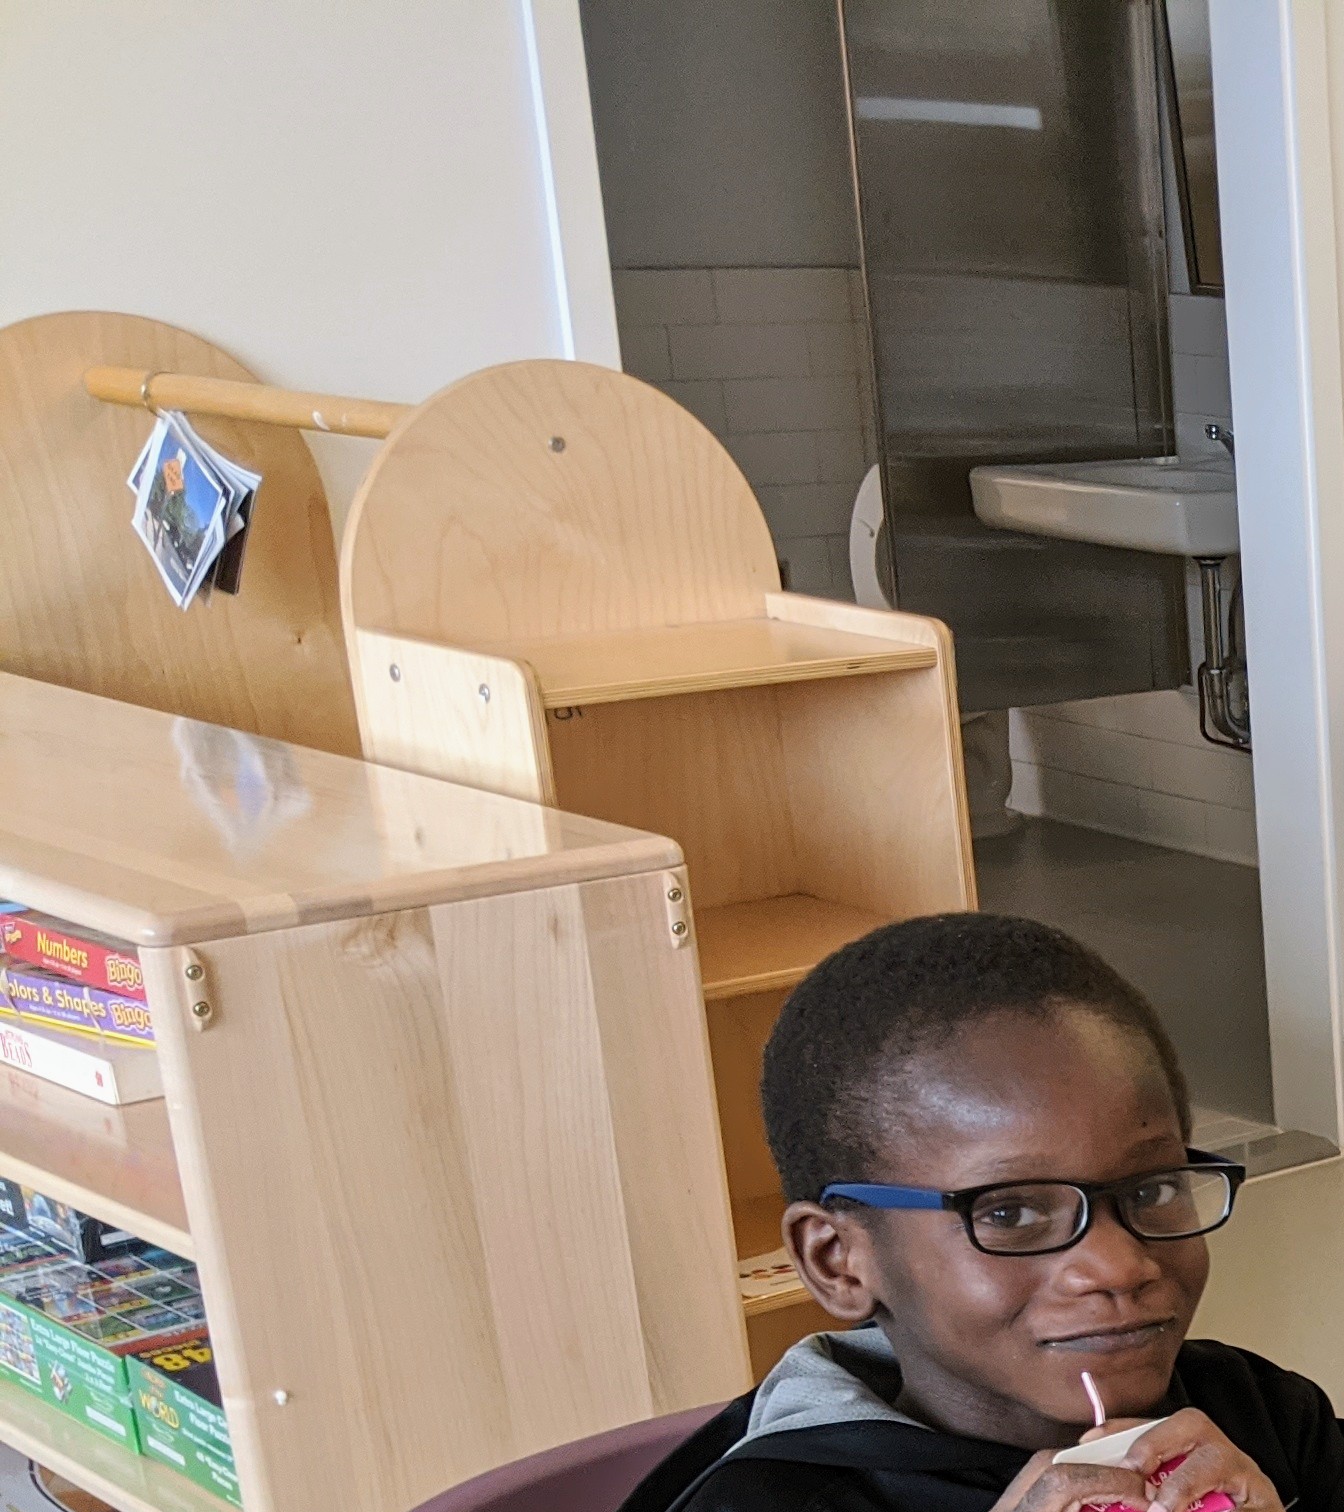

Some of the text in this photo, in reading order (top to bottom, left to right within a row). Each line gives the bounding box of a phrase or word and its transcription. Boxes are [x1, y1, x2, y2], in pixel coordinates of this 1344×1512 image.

[36, 931, 89, 969] Numbers
[107, 958, 143, 989] Bingo
[42, 985, 54, 1006] &
[55, 988, 107, 1018] Shapes
